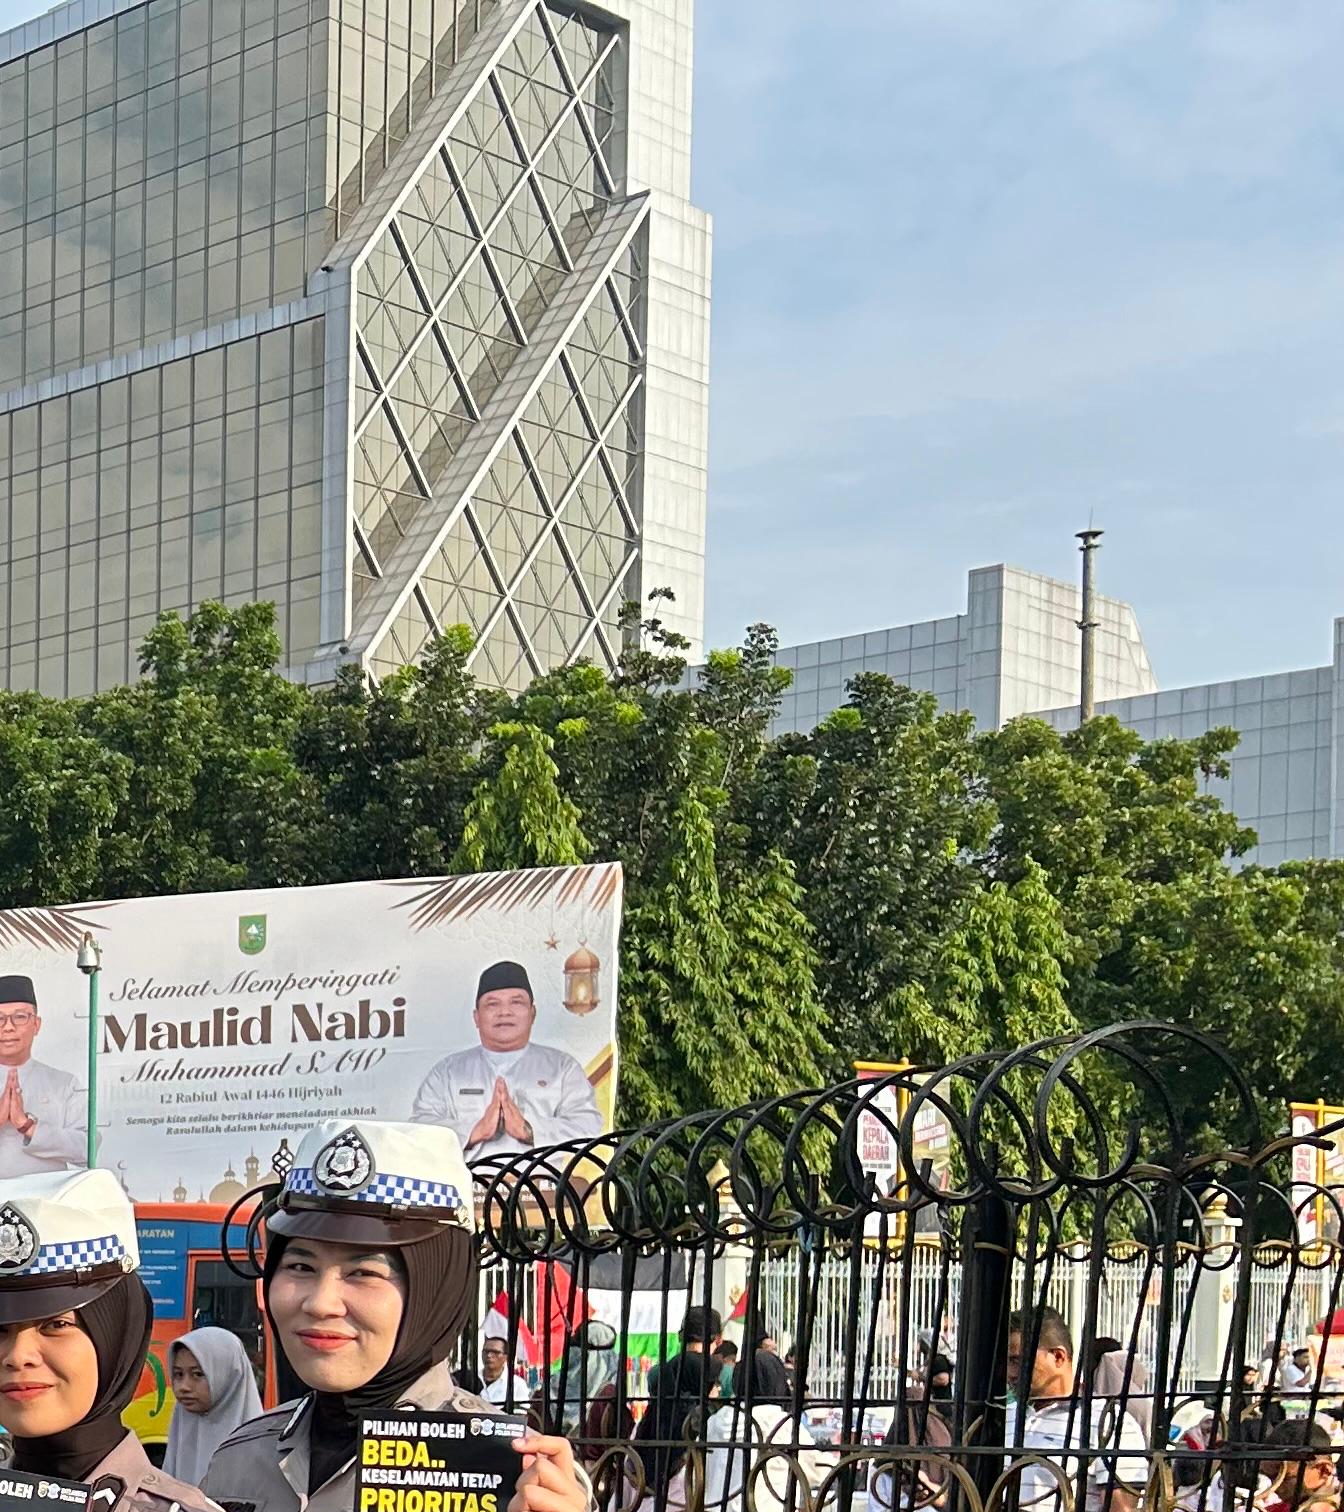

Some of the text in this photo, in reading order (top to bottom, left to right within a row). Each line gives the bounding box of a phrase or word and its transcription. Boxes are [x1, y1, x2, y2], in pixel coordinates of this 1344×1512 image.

[110, 965, 400, 1001] Selamat Memperingati
[103, 997, 406, 1053] Maulid Nabi
[120, 1051, 292, 1083] Muhammad
[160, 1084, 343, 1105] 12 Rabiul Awal 1446 Hijriyah
[166, 1114, 186, 1124] kita
[188, 1113, 218, 1123] selalu
[220, 1110, 274, 1122] berikhtiar
[276, 1107, 337, 1120] meneladani
[339, 1105, 377, 1117] akhlak
[224, 1122, 257, 1134] dalam
[259, 1120, 314, 1134] kehidupan
[362, 1420, 465, 1439] PILIHAN BOLEH
[361, 1468, 502, 1489] KESELAMATAN TETAP
